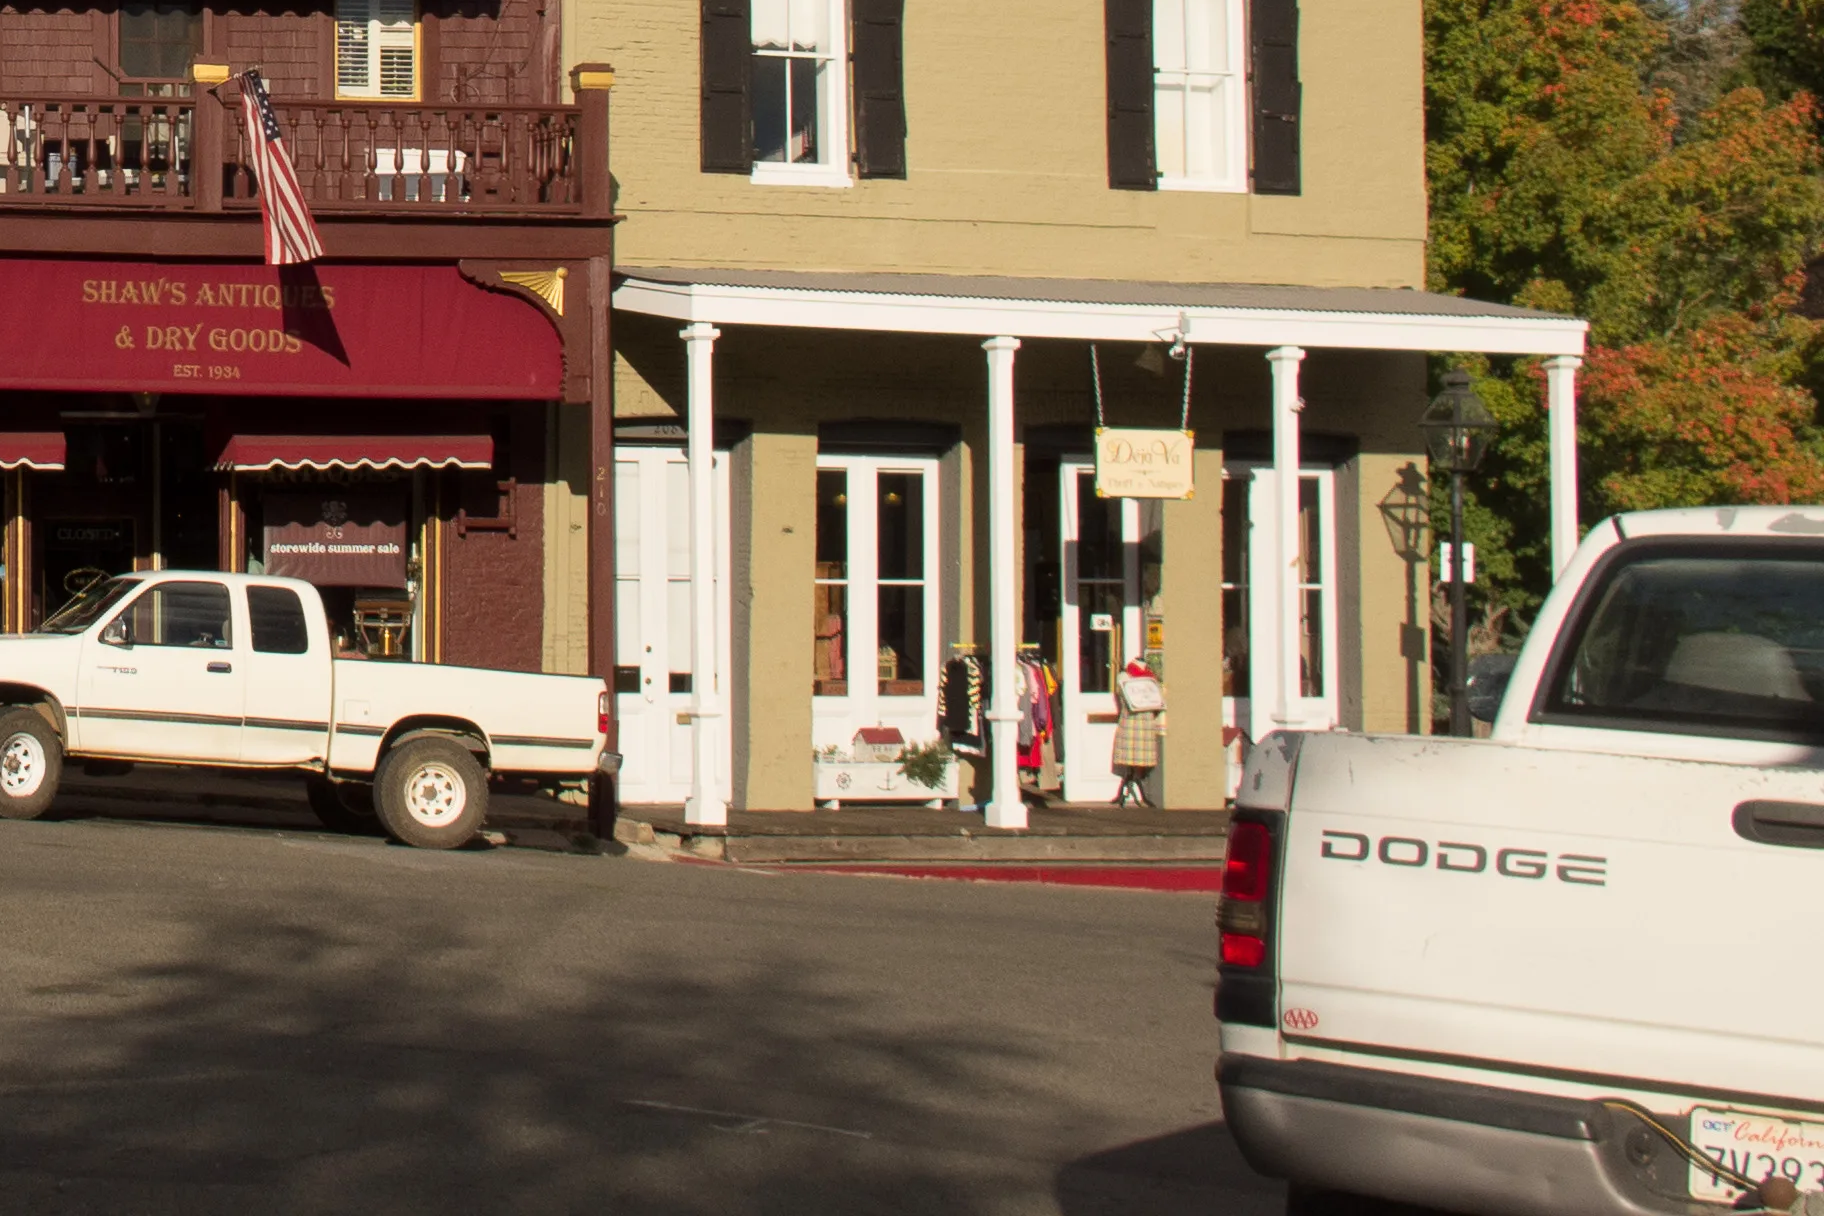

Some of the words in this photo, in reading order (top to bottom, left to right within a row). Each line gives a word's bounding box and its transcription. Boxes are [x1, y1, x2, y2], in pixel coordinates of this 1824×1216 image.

[82, 277, 187, 306] SHAW'S
[195, 282, 335, 310] ANTIQUES
[114, 325, 135, 350] &
[145, 322, 204, 352] DRY
[208, 327, 302, 353] GOODS
[173, 364, 203, 378] EST.
[208, 366, 241, 379] 1934
[270, 542, 326, 554] storewide
[328, 544, 376, 554] summer
[377, 542, 400, 554] sale
[1321, 829, 1608, 887] DODGE
[1284, 1008, 1318, 1030] AAA
